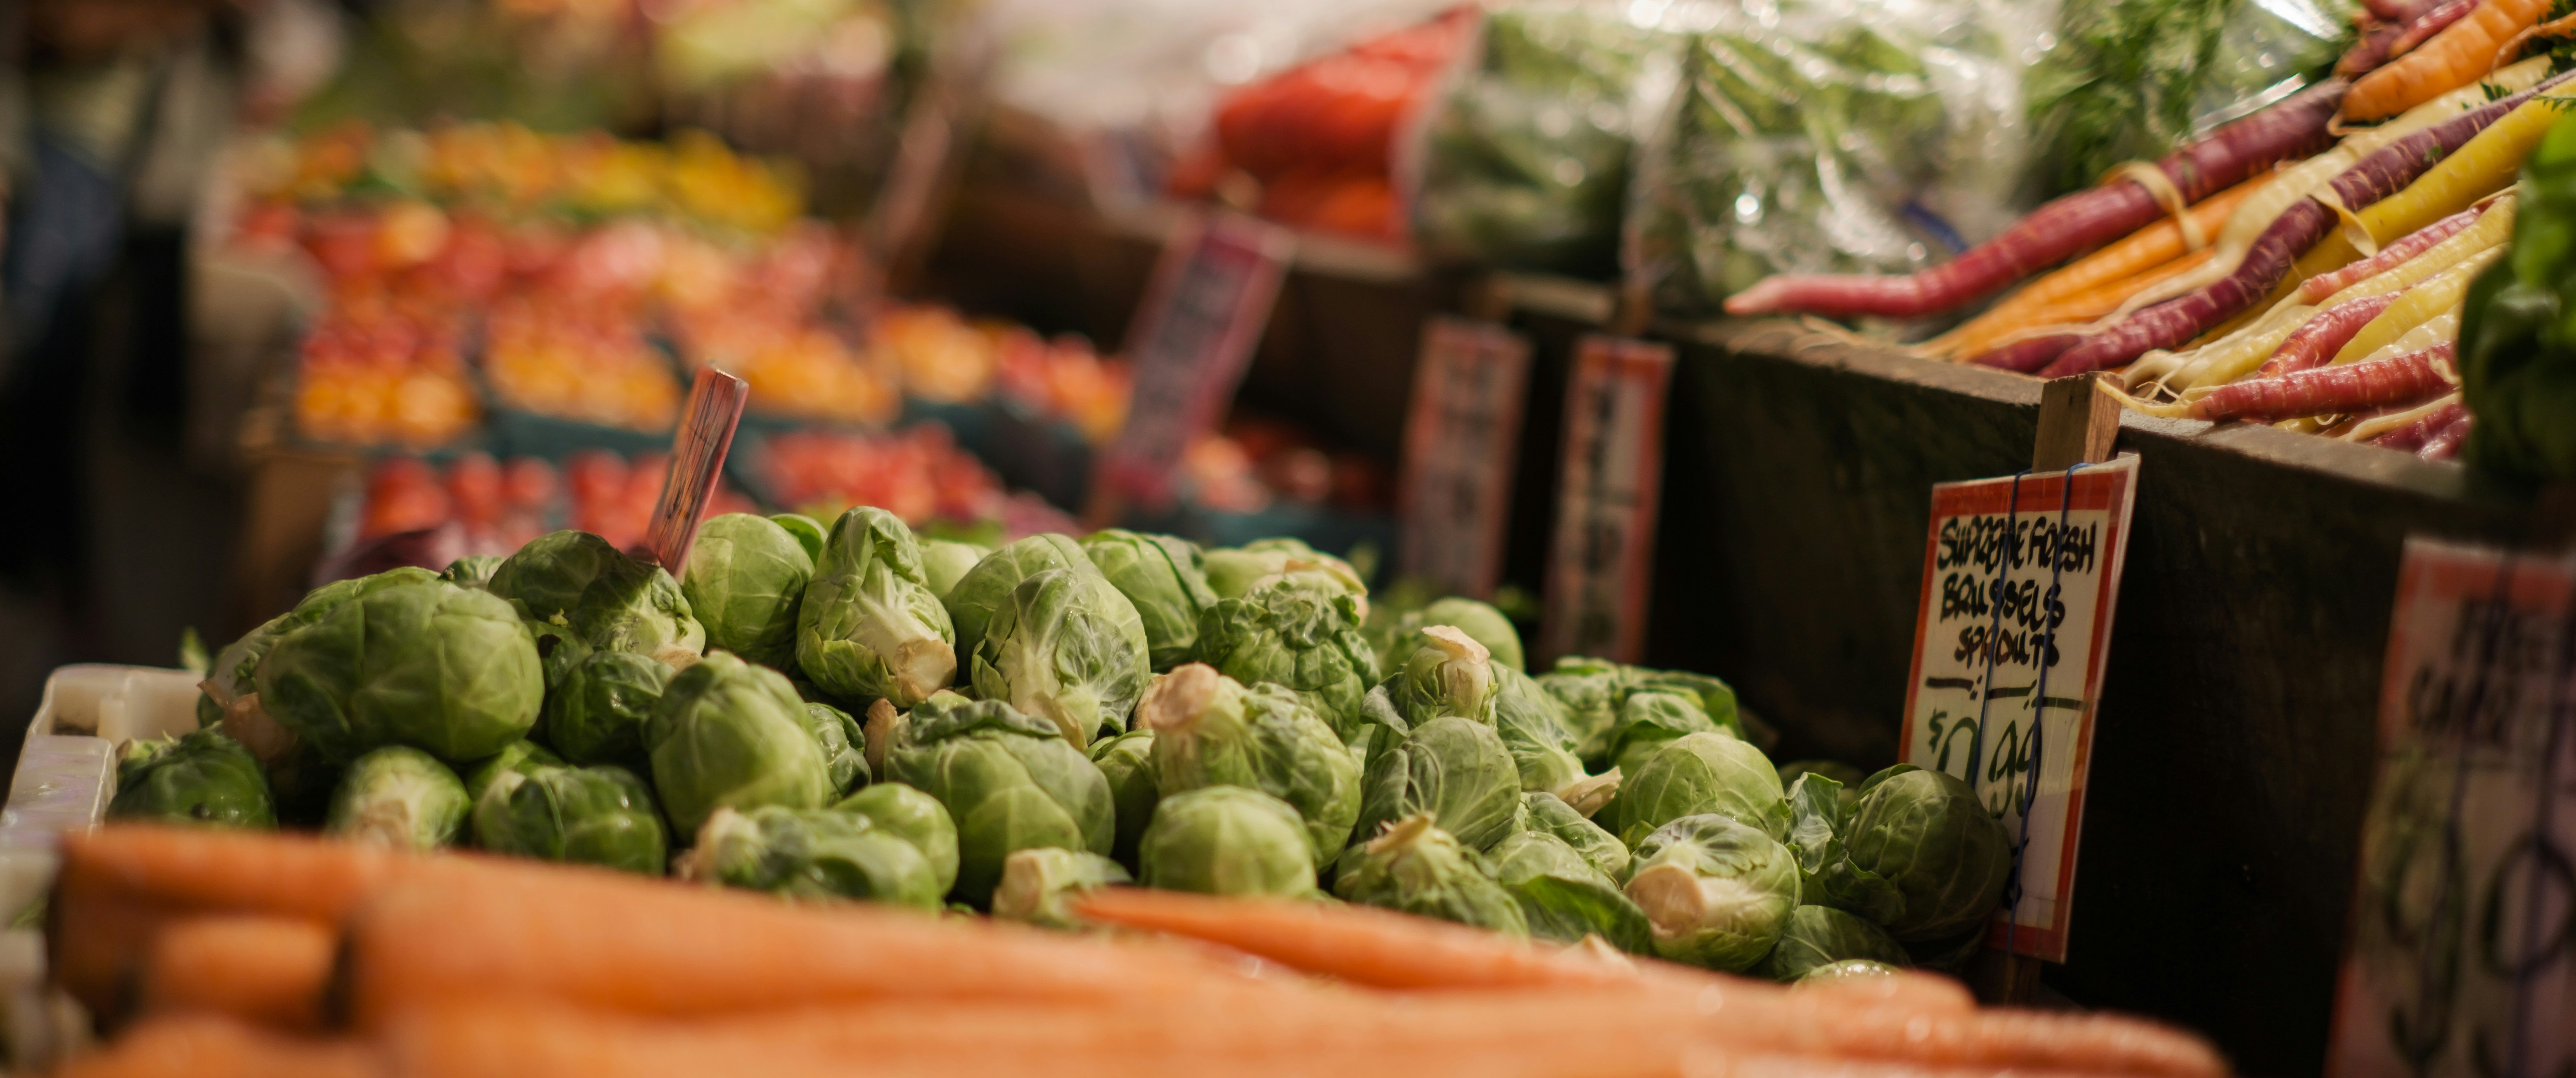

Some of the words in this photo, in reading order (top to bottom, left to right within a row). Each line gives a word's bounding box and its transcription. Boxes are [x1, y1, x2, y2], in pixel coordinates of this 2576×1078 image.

[2027, 516, 2097, 575] FRESH
[1940, 572, 2066, 633] BRUSSELS
[1954, 622, 2060, 670] SPROUTS
